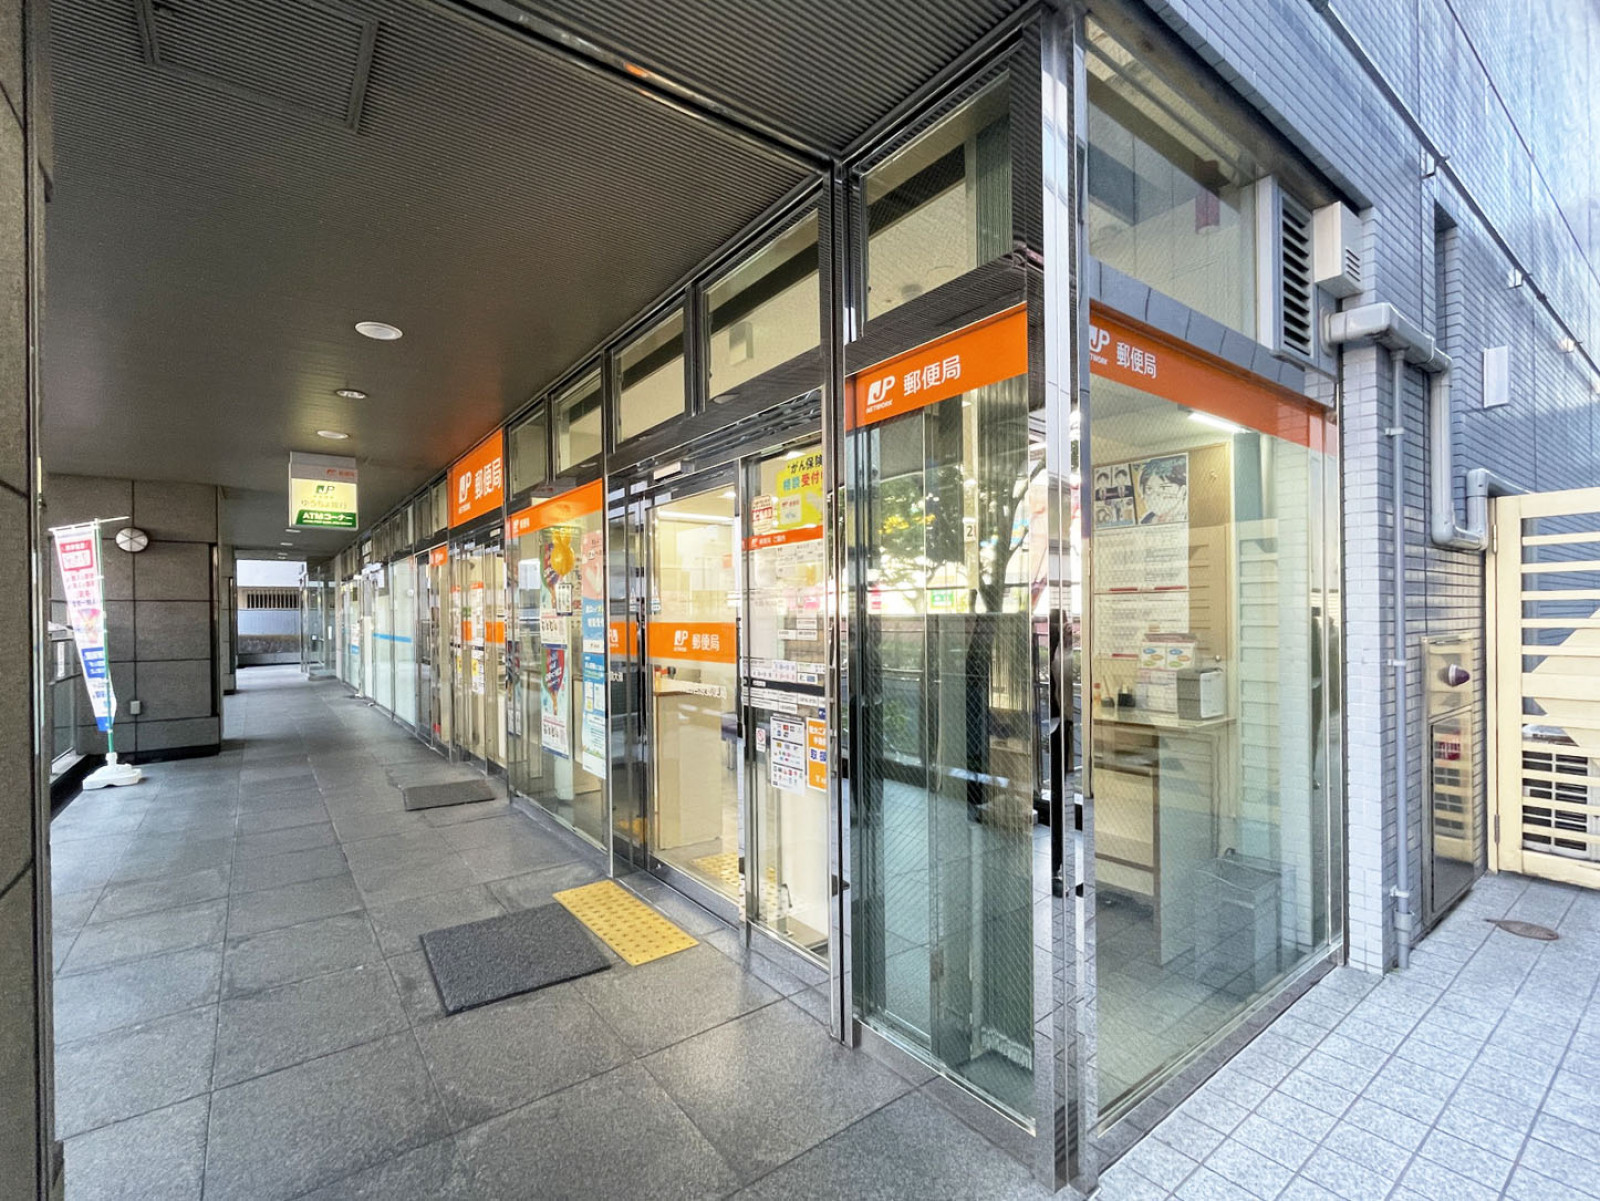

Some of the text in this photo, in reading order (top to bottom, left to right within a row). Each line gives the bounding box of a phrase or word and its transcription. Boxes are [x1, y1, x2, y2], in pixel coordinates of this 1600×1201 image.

[1116, 341, 1157, 379] 郵便局
[866, 354, 961, 407] JP 郵便局
[866, 399, 893, 414] NETWORK
[474, 456, 501, 501] 郵便局
[302, 512, 353, 520] ATMコーナー
[692, 633, 720, 652] 郵便局
